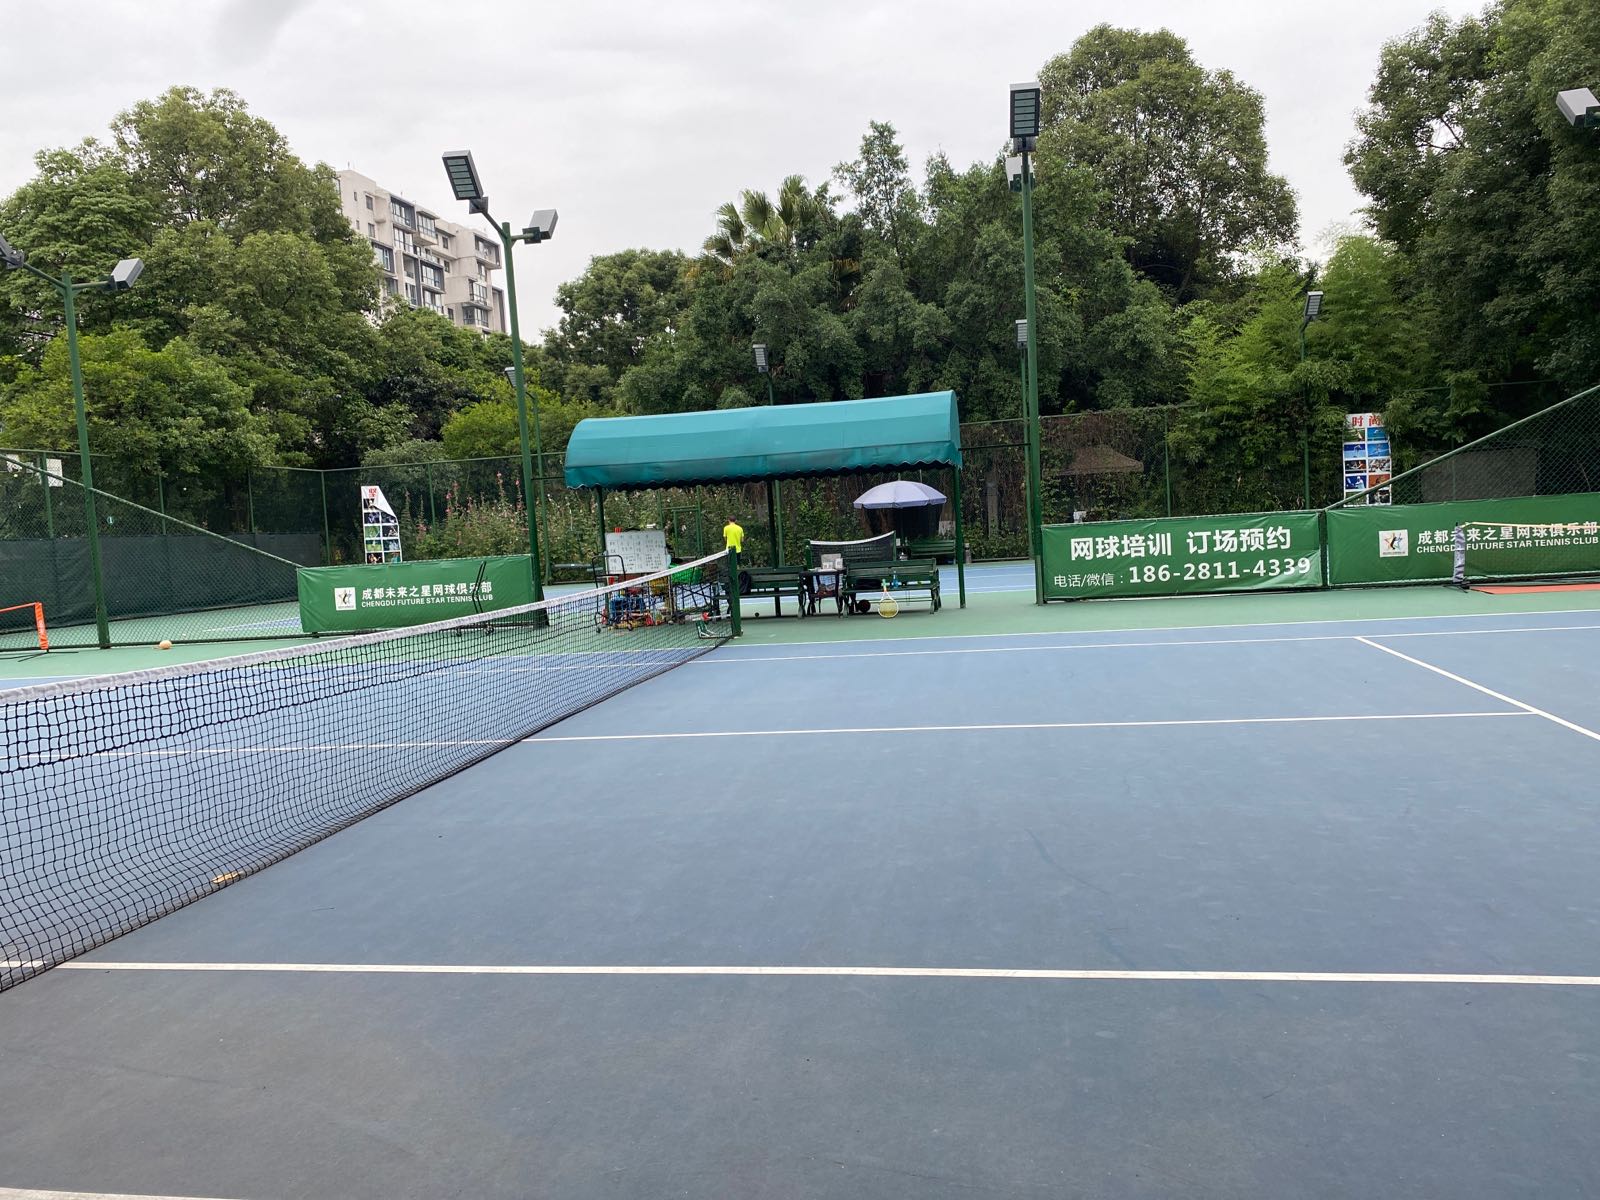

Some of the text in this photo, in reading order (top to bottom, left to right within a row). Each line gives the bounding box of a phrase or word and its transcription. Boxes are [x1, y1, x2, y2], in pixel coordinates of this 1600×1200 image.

[1070, 525, 1291, 561] 网球培训 订场预约
[1416, 536, 1599, 554] CHENGD FUTURE STAR TENNIS CLUB
[1128, 557, 1311, 584] 186-2811-4339
[361, 600, 396, 608] CHENGDU
[397, 597, 425, 606] FUTURE
[425, 596, 446, 604] STAR
[446, 594, 473, 603] TENNIS
